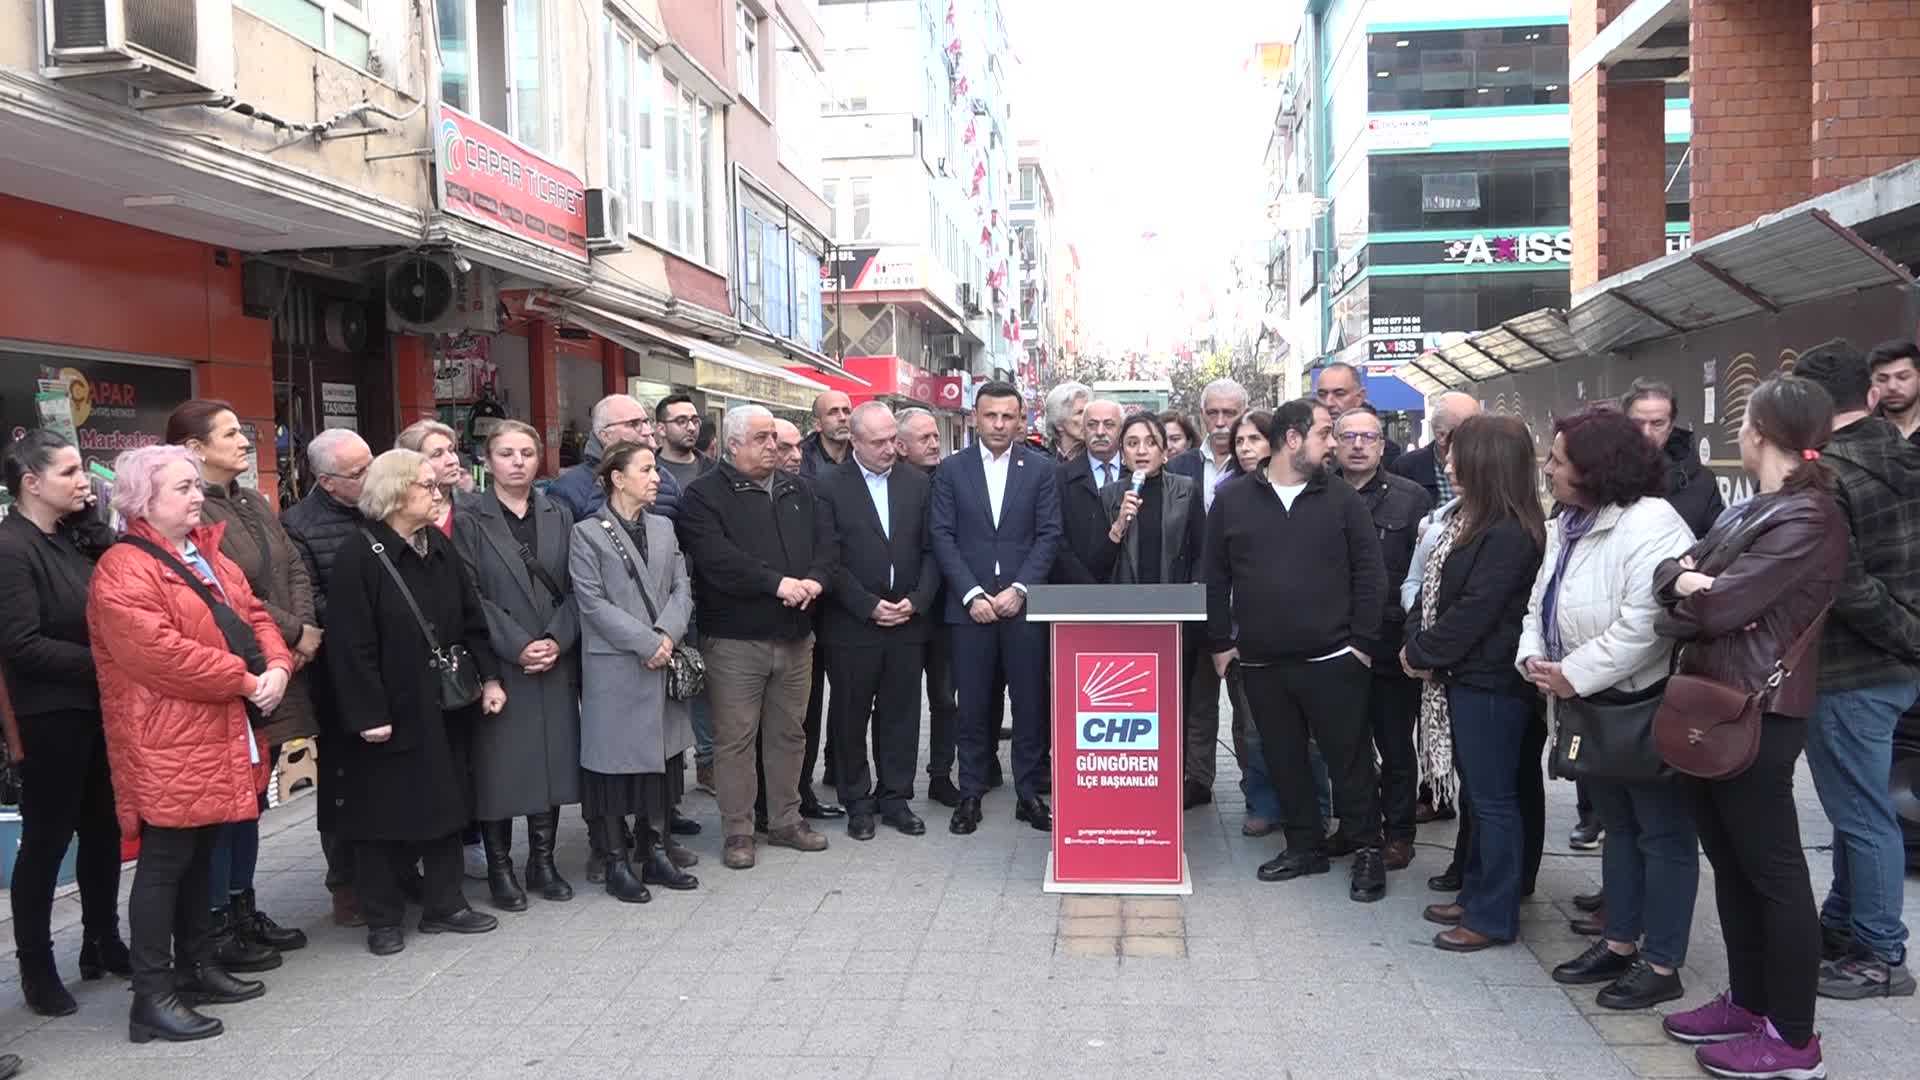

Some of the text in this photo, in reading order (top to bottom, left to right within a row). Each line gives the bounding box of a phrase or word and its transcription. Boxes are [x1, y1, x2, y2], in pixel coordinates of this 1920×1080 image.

[1464, 231, 1571, 265] AXISS
[1376, 340, 1416, 352] AXISS
[1083, 718, 1152, 742] CHP
[1076, 753, 1158, 772] GÜNGÖREN
[1077, 774, 1158, 789] İLÇE BAŞKANLIĞI
